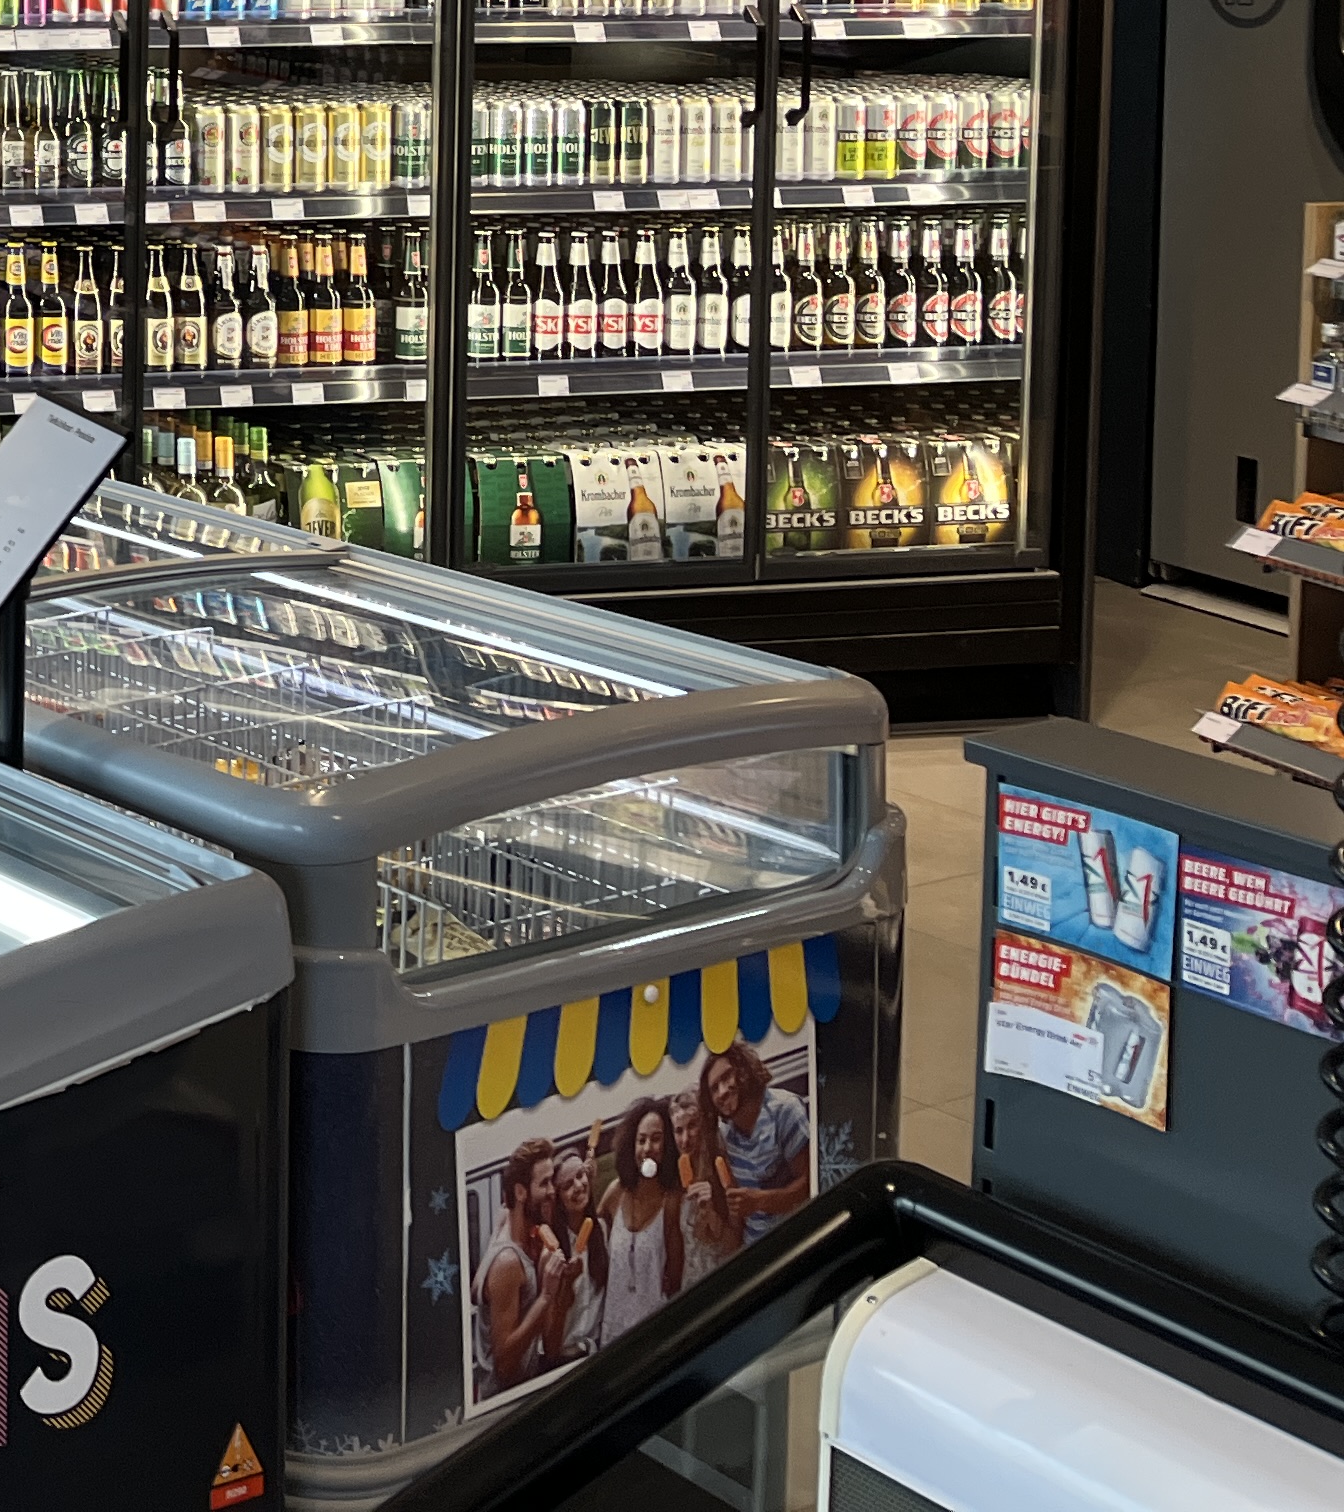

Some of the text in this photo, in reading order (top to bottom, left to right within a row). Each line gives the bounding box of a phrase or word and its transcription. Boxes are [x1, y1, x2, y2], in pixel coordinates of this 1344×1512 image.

[580, 487, 627, 503] Krombacher
[669, 484, 716, 500] Krombacher
[765, 510, 836, 529] BECK'S
[848, 508, 924, 527] BECK'S
[936, 503, 1010, 523] BECK'S
[1003, 798, 1038, 819] HIER
[1004, 816, 1066, 842] ENERGY!
